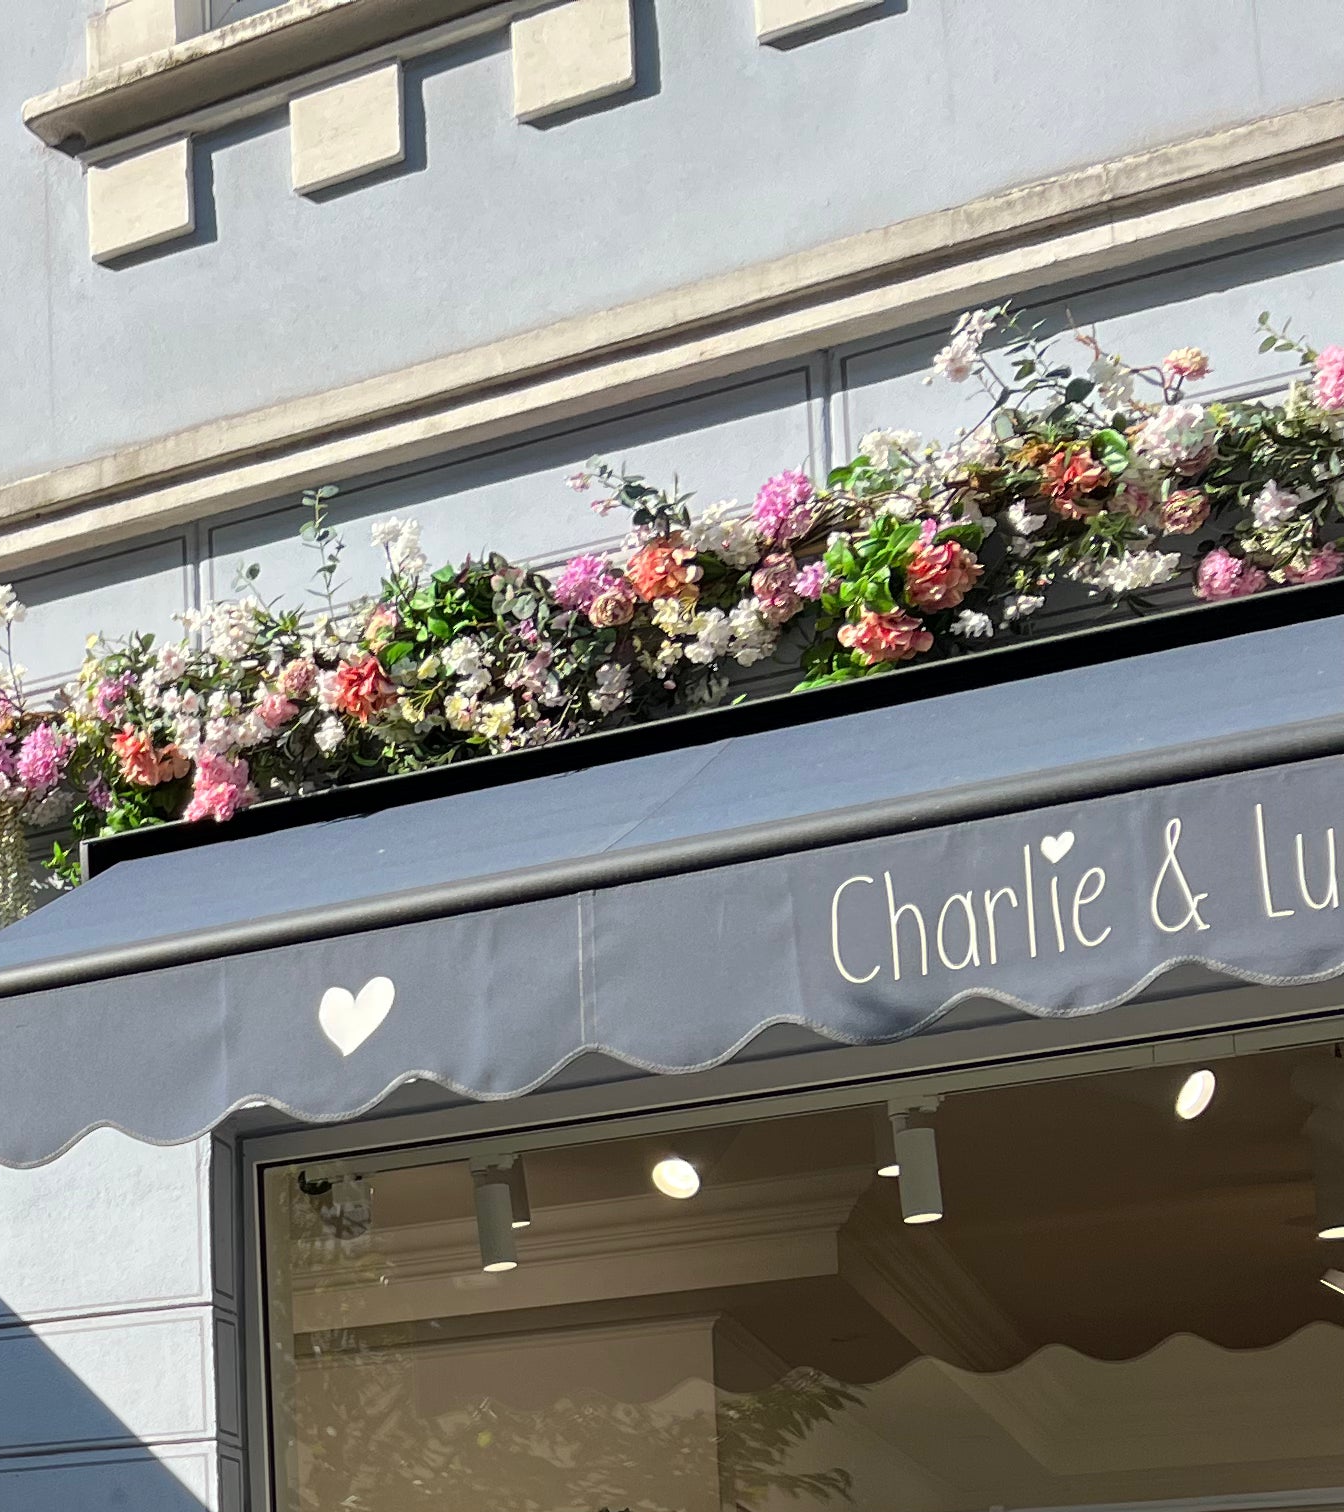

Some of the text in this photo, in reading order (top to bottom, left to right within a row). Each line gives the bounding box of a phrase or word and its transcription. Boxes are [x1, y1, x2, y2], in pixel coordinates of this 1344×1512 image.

[831, 803, 1341, 984] Charlie & Lu
